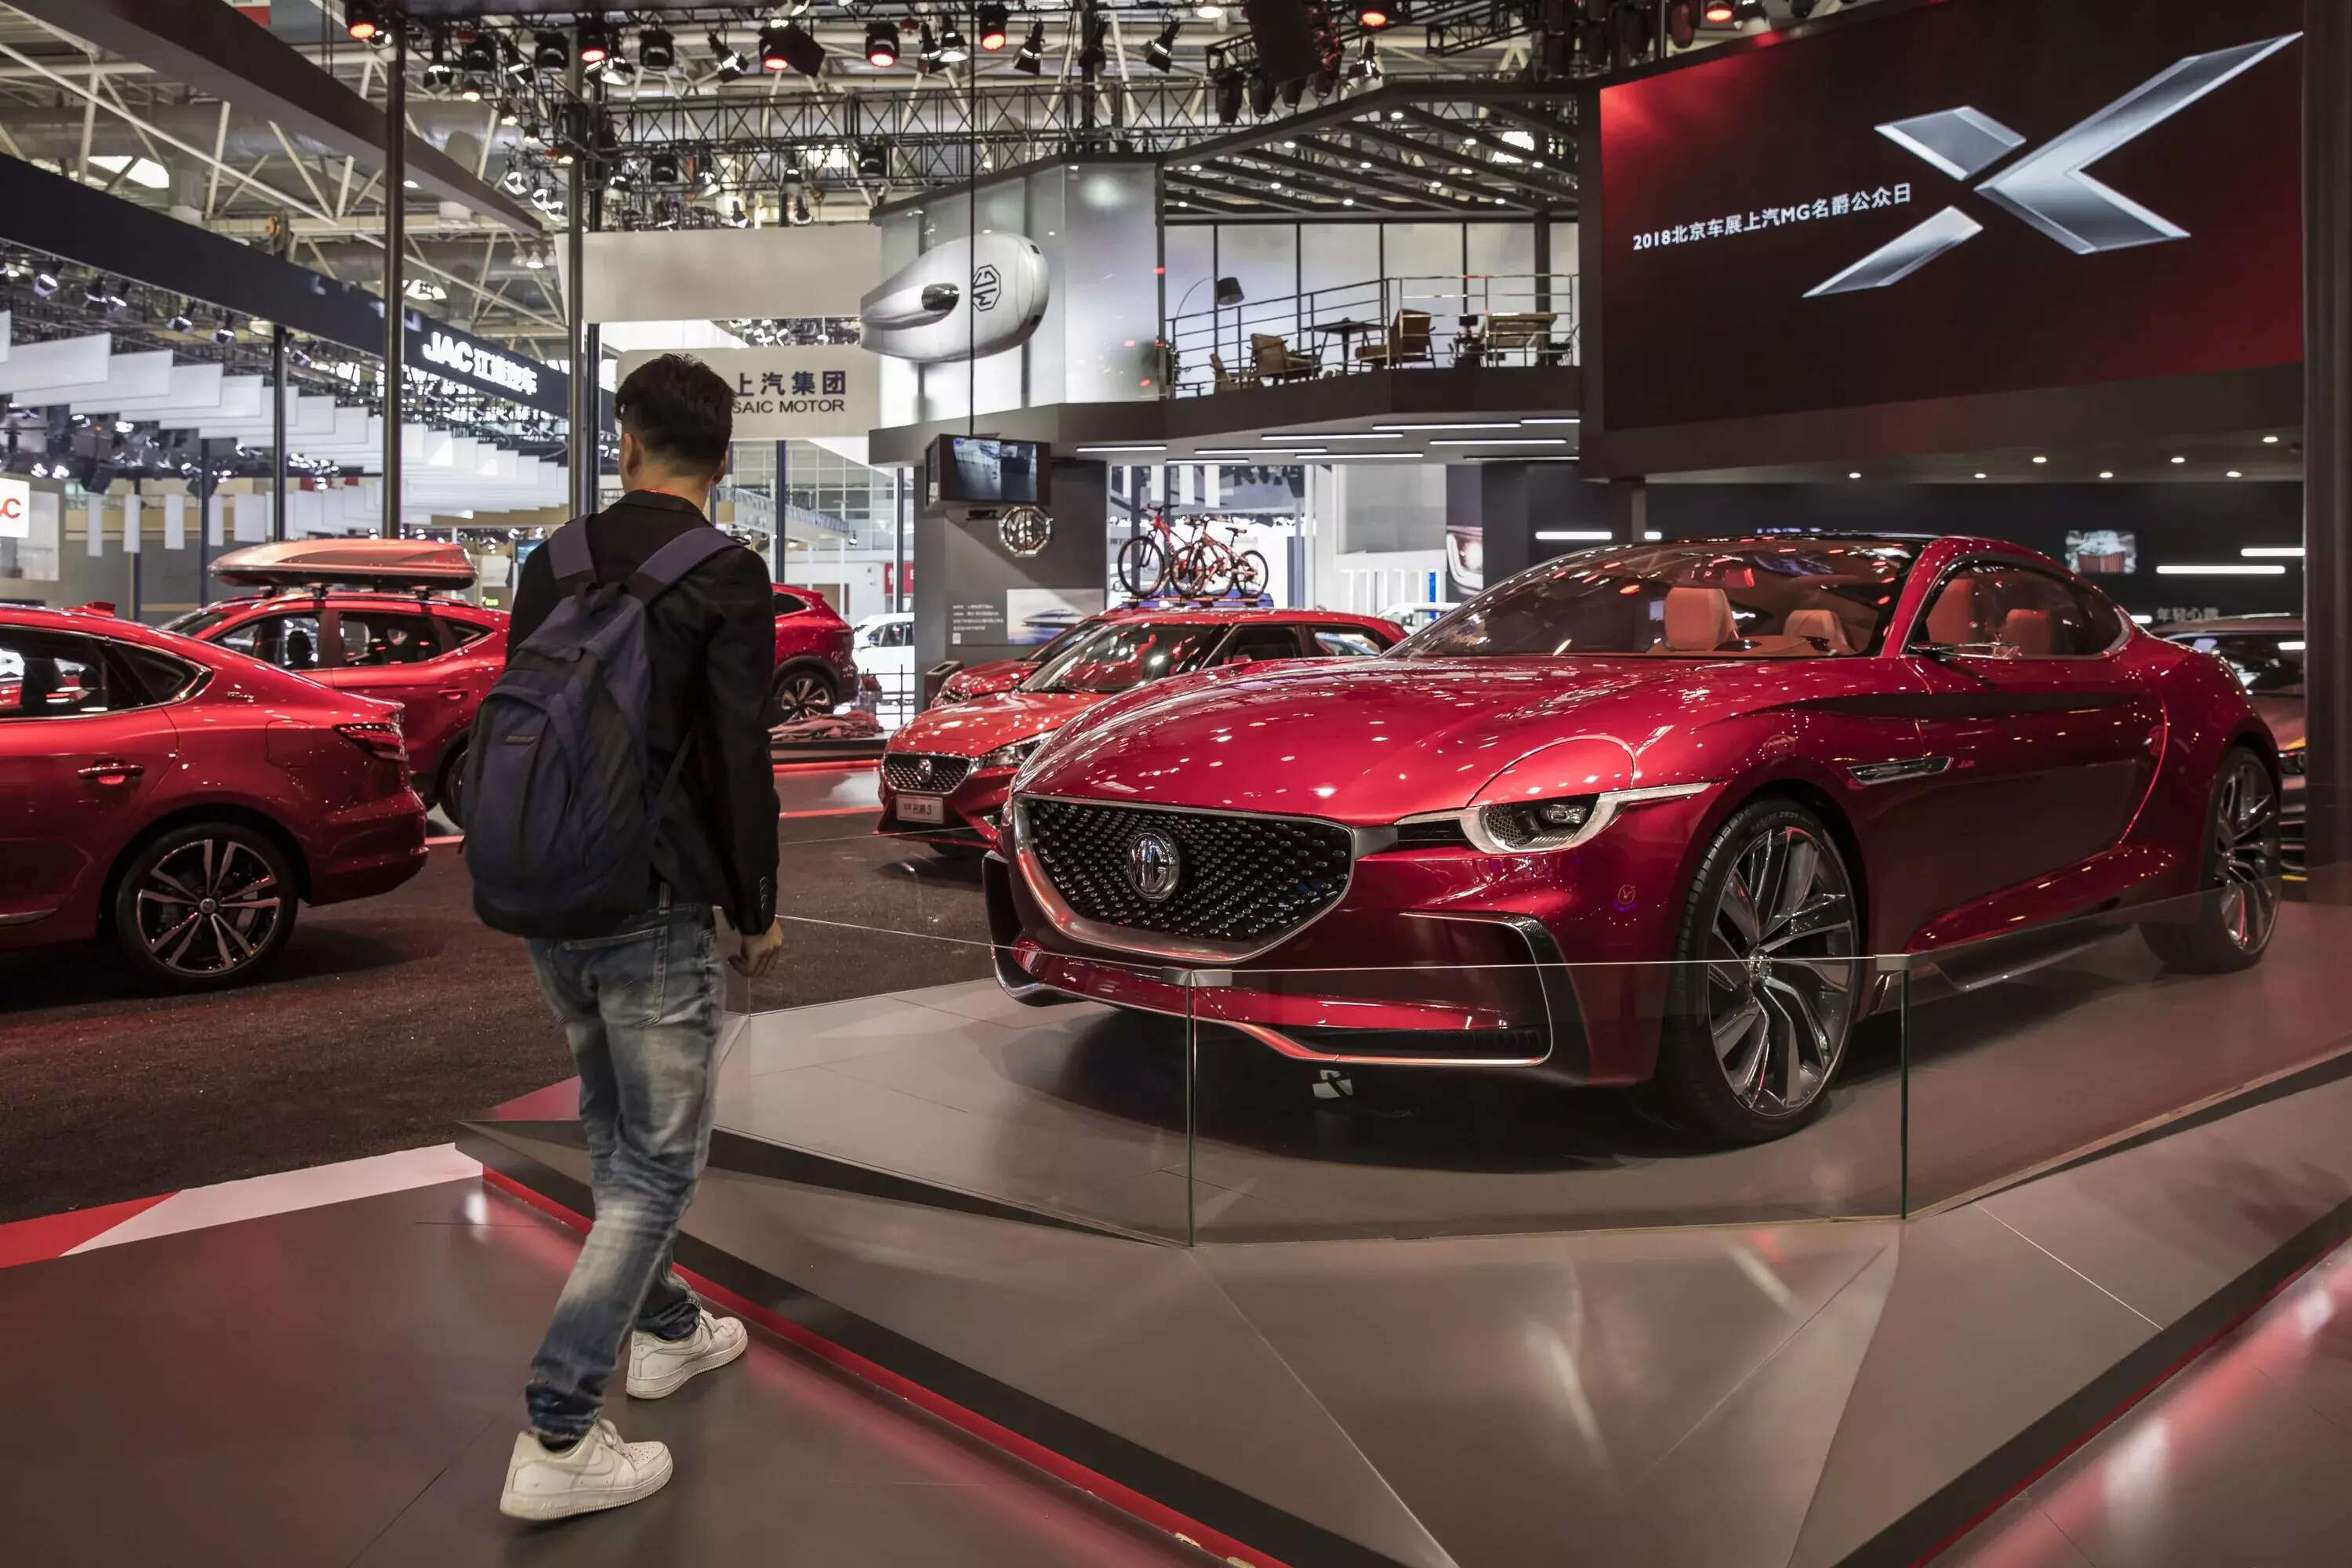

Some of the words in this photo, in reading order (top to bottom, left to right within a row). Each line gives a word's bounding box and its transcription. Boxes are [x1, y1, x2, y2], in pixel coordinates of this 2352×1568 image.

[1632, 182, 1911, 251] 2018北京车展上汽MG名爵公众日
[422, 331, 474, 373] JAC
[738, 371, 845, 397] 上汽集团
[779, 399, 845, 413] MOTOR
[1130, 837, 1169, 895] MG
